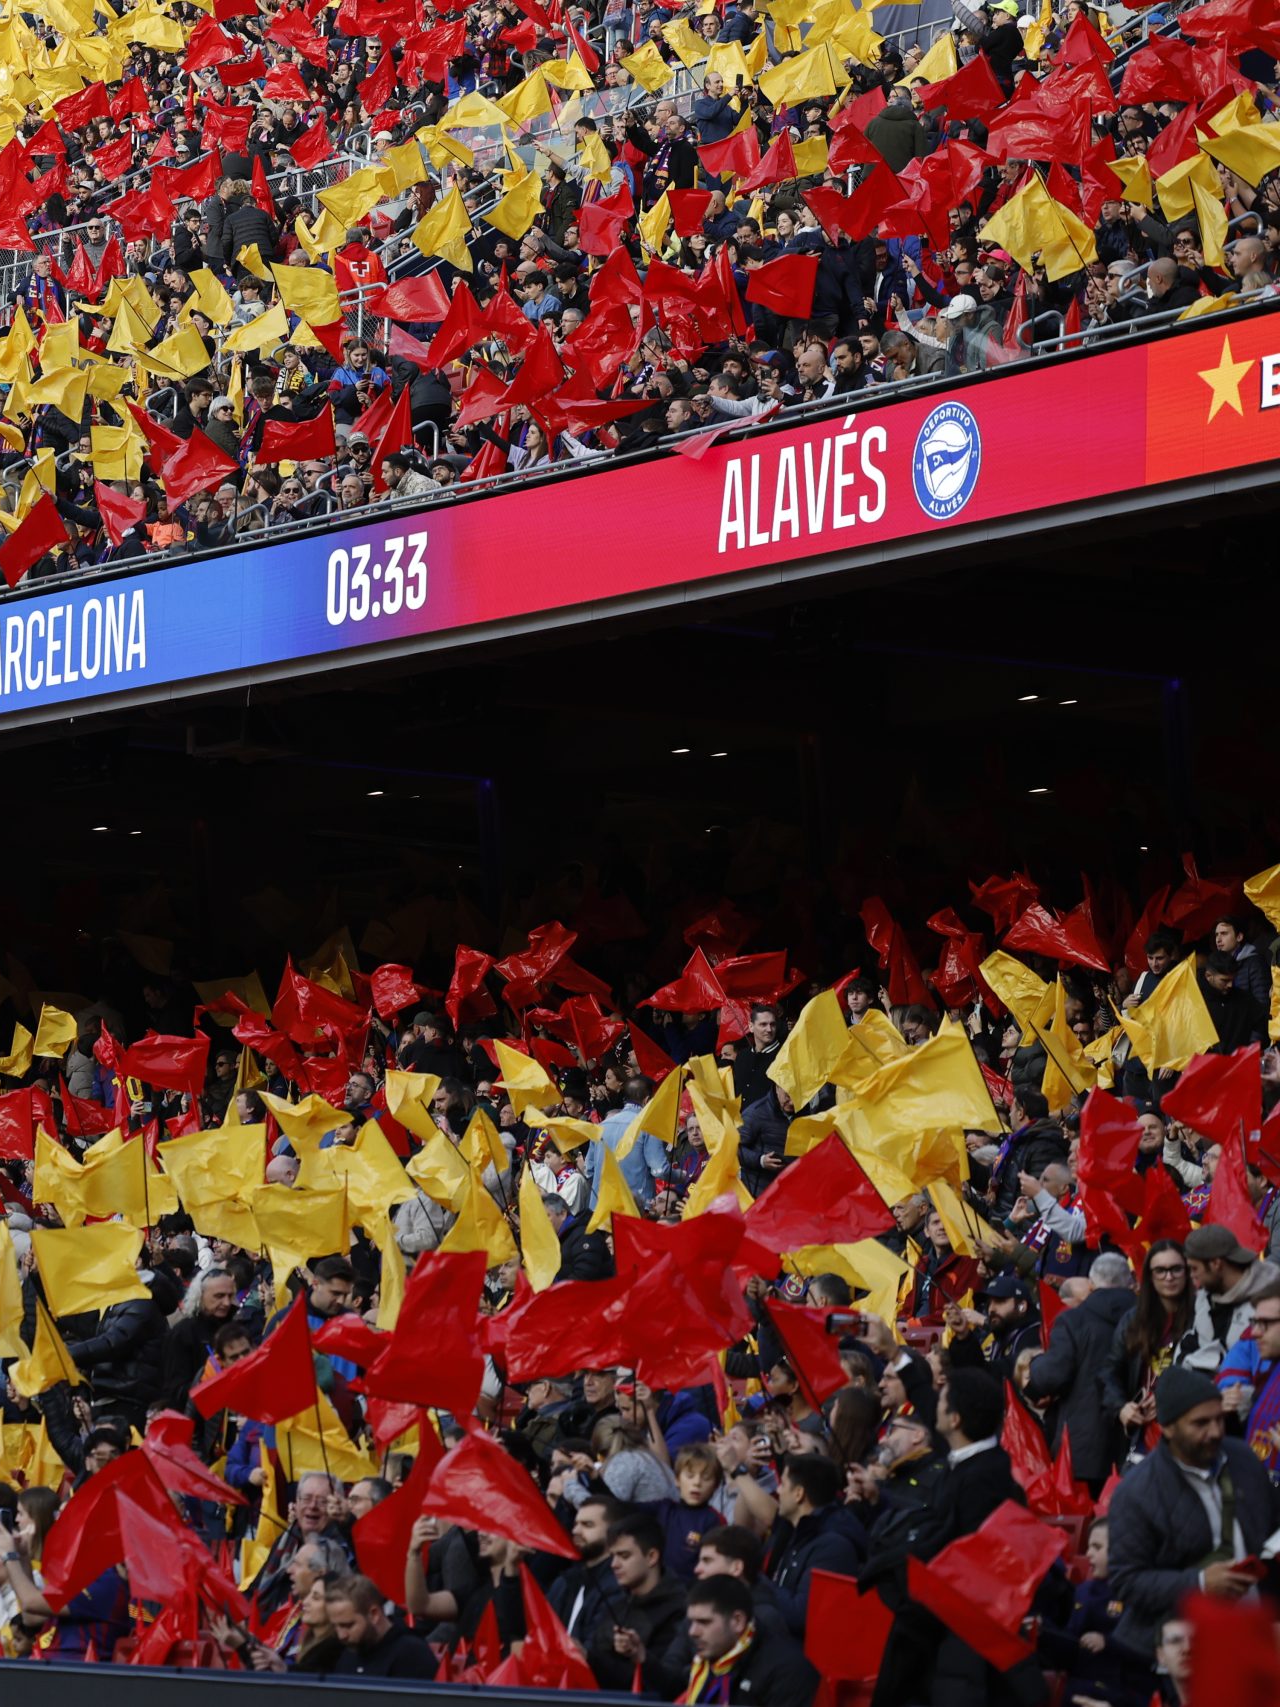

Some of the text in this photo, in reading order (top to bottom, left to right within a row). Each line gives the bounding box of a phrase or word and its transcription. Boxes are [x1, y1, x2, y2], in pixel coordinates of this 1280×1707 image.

[923, 407, 971, 437] DEPORTIVO
[718, 412, 888, 553] ALAVÉS
[326, 531, 428, 626] 03:33
